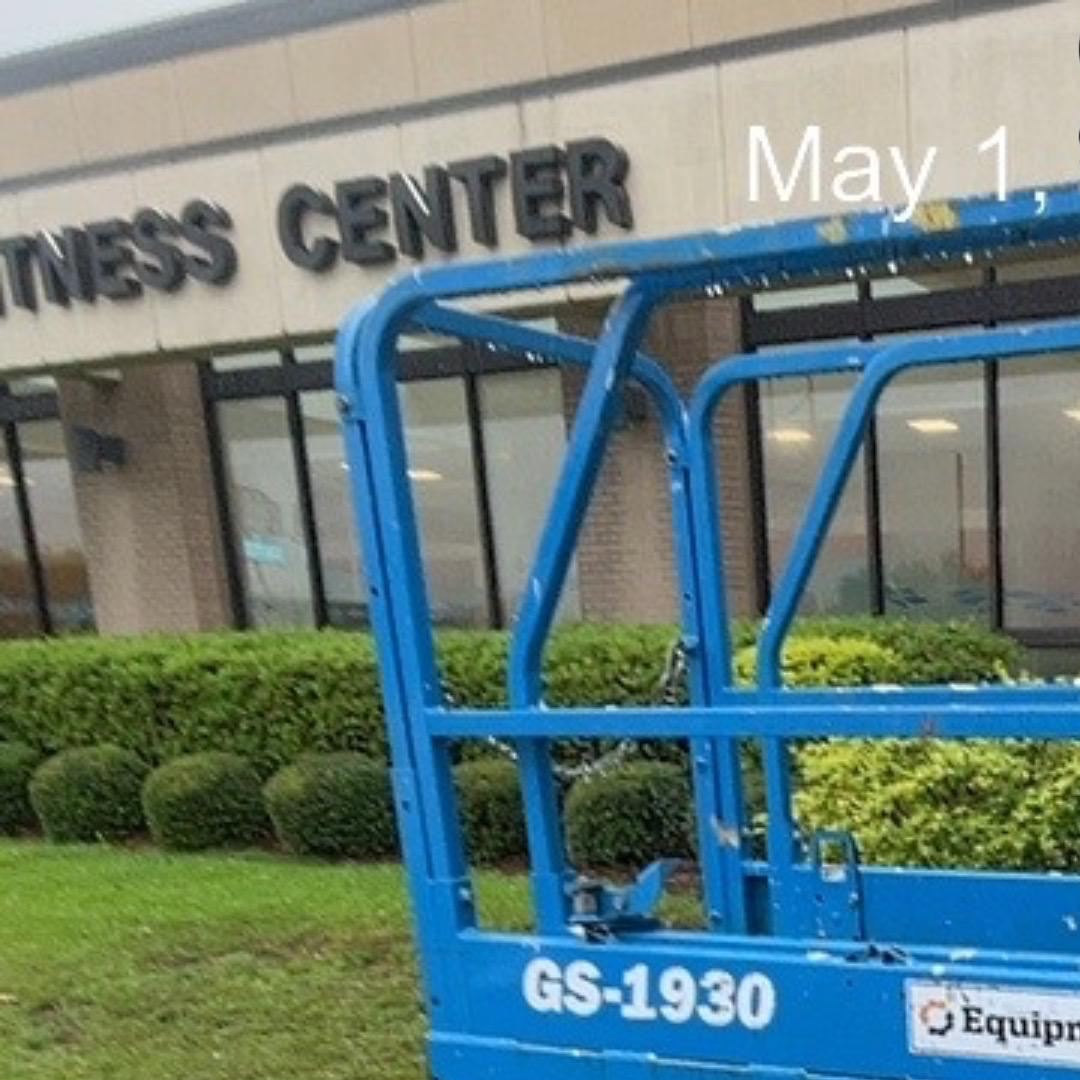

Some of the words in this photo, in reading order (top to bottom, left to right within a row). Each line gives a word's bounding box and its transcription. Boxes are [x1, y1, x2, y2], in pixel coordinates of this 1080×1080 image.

[0, 197, 239, 317] TNESS
[277, 136, 634, 273] CENTER
[522, 957, 776, 1030] GS-1930
